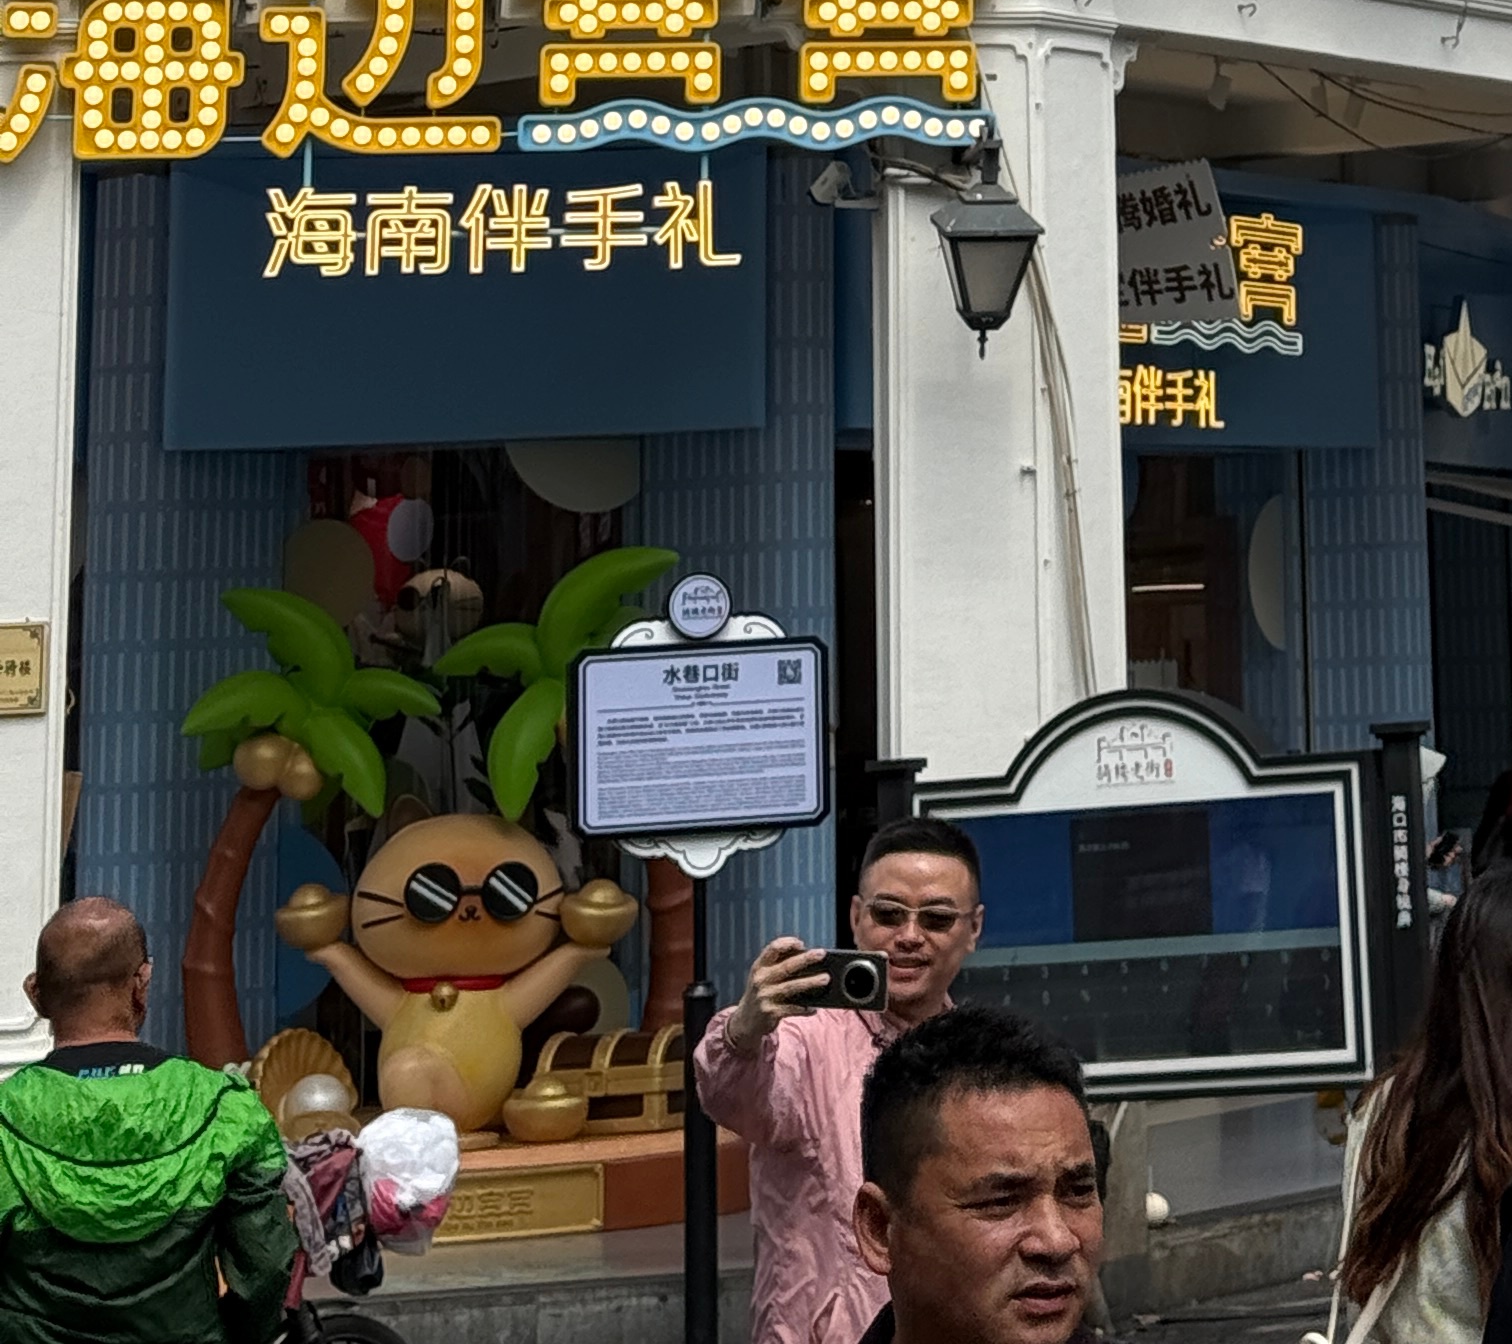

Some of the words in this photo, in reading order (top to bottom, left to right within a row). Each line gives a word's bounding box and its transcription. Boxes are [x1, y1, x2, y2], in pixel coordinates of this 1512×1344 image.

[263, 180, 742, 279] 海南伴手礼
[662, 661, 740, 685] 水巷口街
